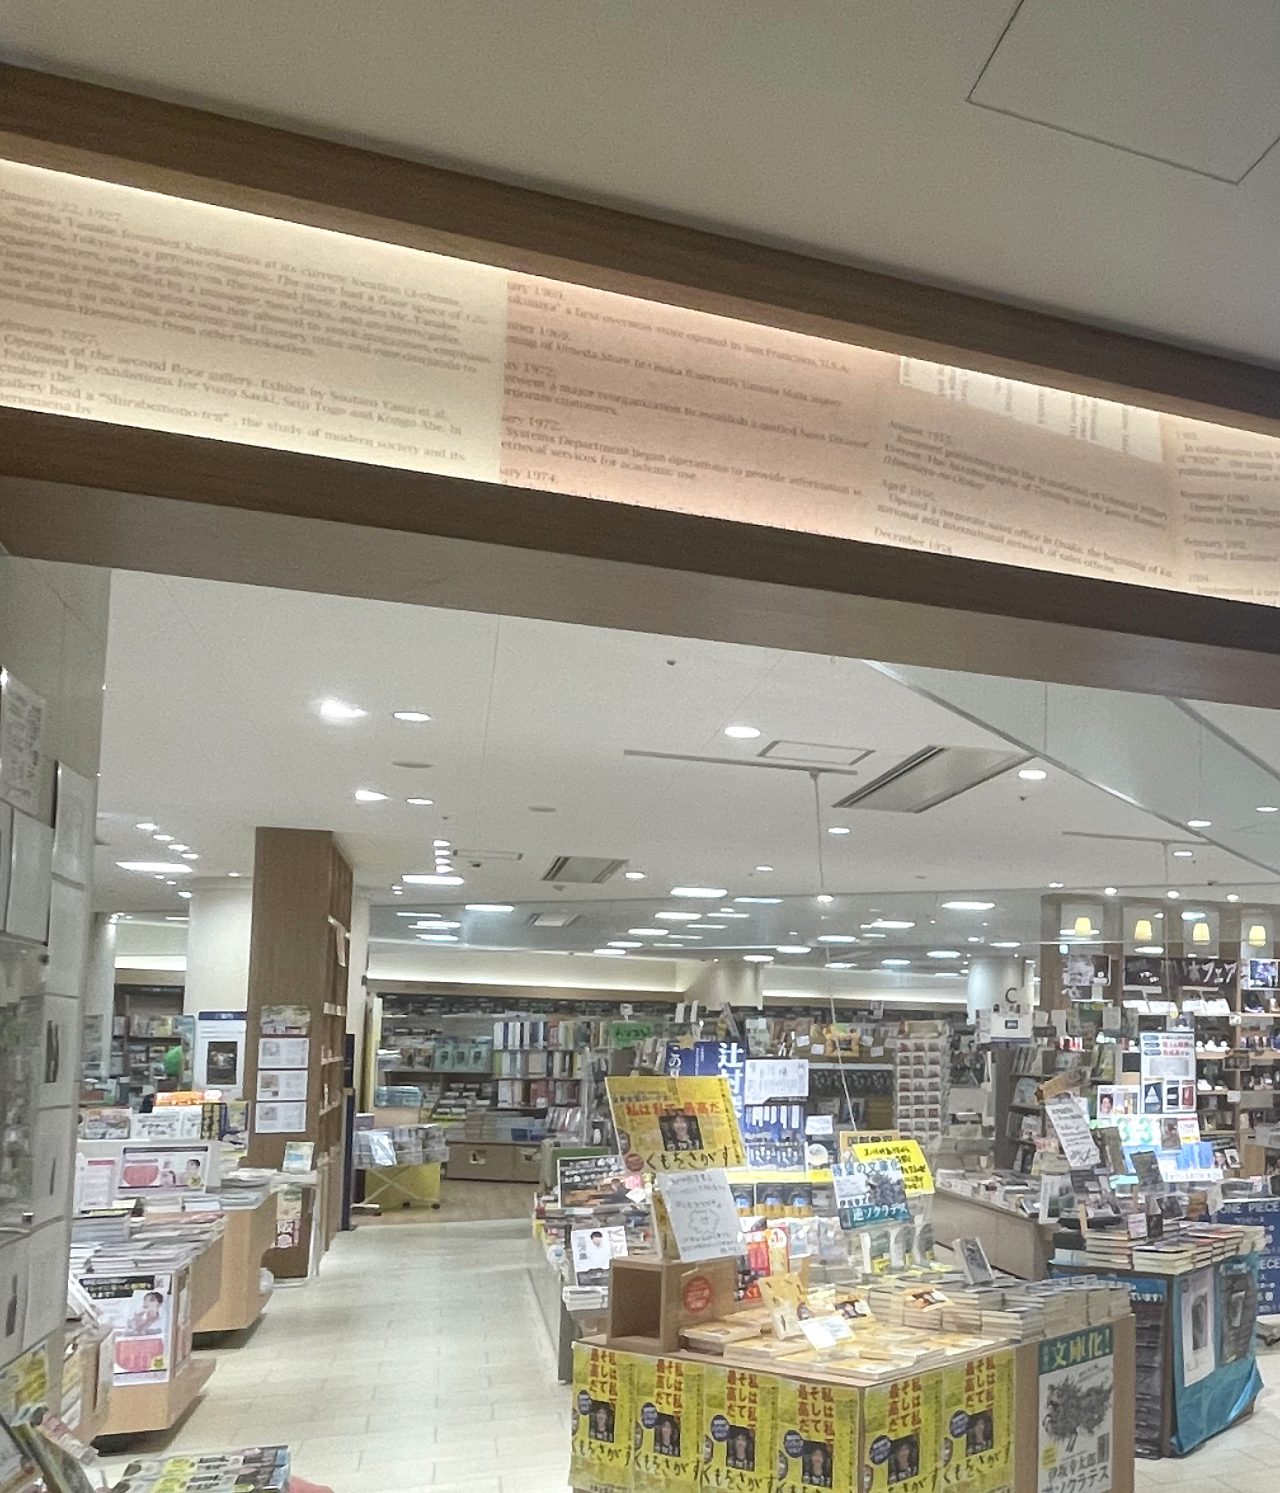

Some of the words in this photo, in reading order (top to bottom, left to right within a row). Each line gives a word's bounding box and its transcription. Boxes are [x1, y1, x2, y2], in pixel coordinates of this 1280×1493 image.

[70, 345, 84, 358] of
[90, 348, 112, 363] the
[117, 353, 165, 372] second
[73, 360, 87, 373] by
[95, 363, 173, 387] exhibitions
[177, 377, 199, 392] for
[349, 407, 373, 421] and
[241, 415, 262, 429] the
[266, 419, 301, 435] study
[307, 426, 320, 438] of
[324, 429, 373, 447] modern
[377, 437, 419, 454] society
[423, 445, 445, 459] and
[449, 449, 466, 462] its
[646, 1146, 729, 1172] くもをさがす
[1219, 1202, 1243, 1214] ONE
[1248, 1201, 1280, 1213] PIECE
[1259, 1259, 1280, 1270] ECE
[600, 1350, 608, 1393] そして
[665, 1360, 673, 1404] そして
[976, 1358, 984, 1402] そして
[737, 1373, 747, 1417] そして
[809, 1387, 822, 1432] そして
[901, 1380, 909, 1426] そして
